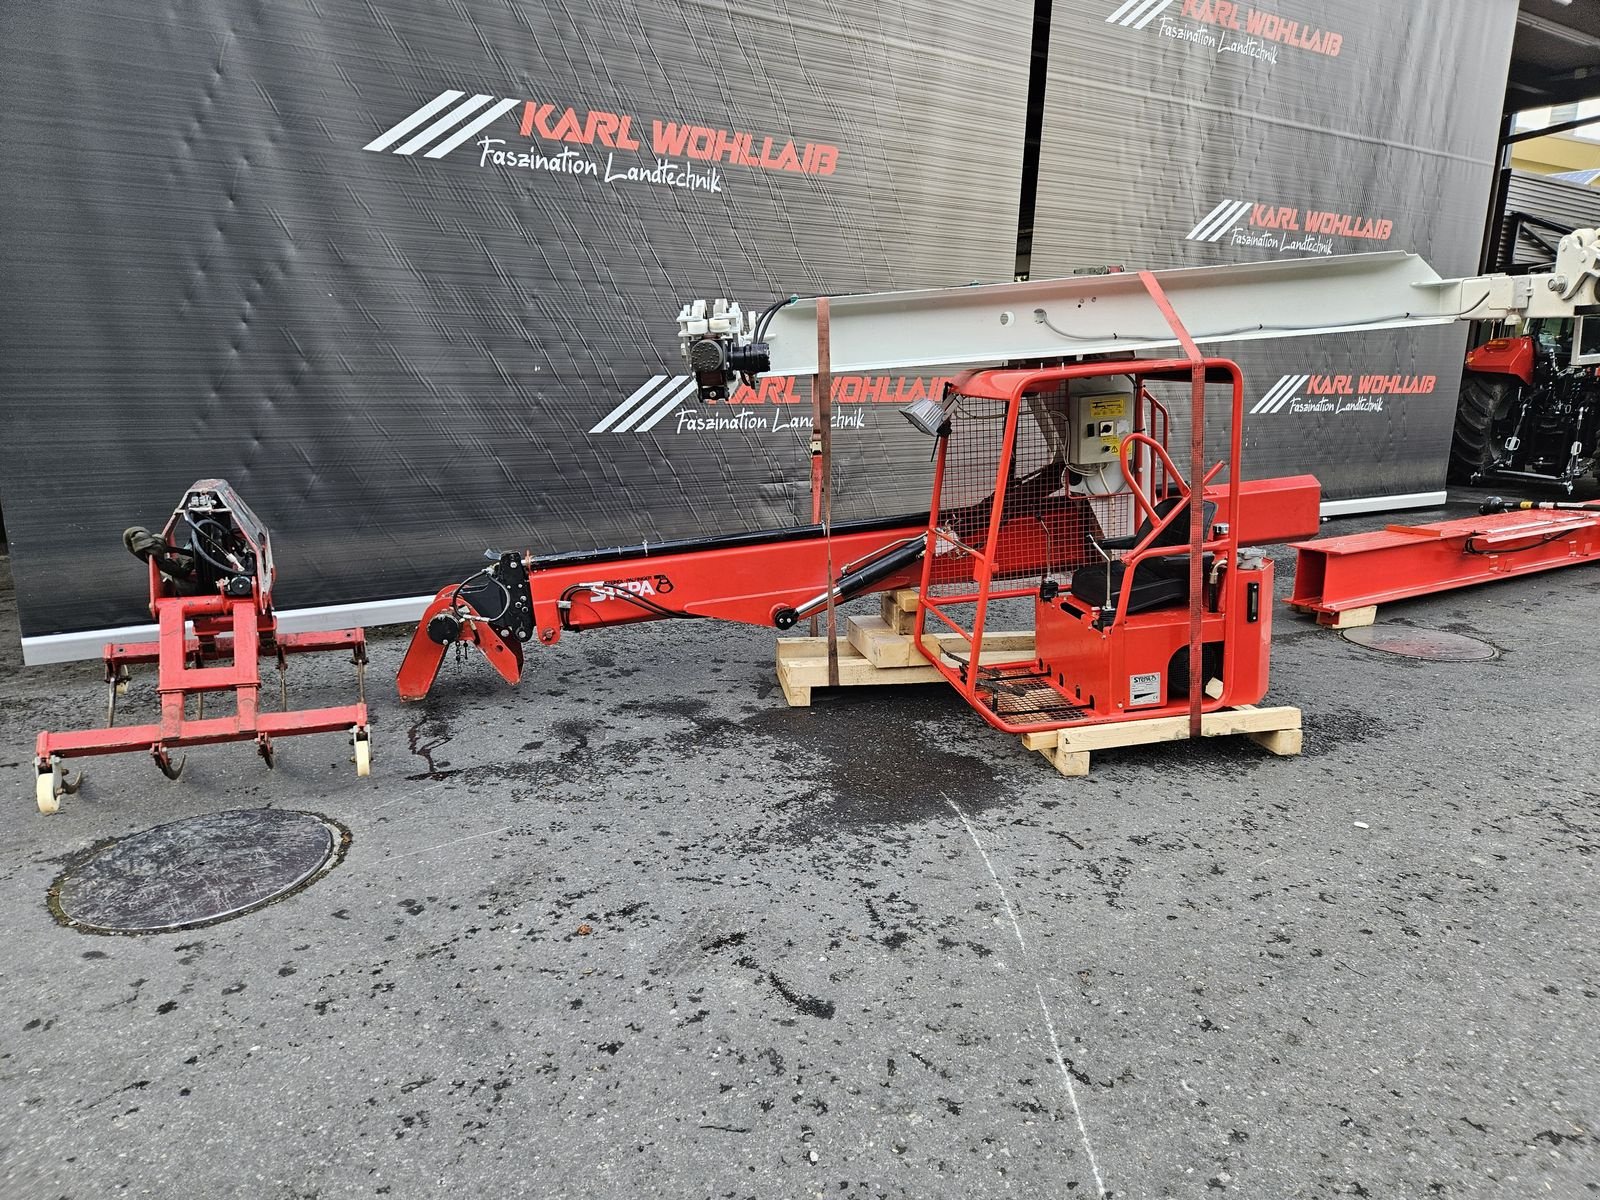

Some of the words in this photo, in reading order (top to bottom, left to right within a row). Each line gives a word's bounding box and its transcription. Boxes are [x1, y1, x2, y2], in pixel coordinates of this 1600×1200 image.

[1181, 0, 1240, 30] KARL
[1159, 15, 1216, 48] Faszination
[1217, 31, 1278, 64] Landtechnik
[520, 101, 640, 151] KARL
[477, 136, 598, 176] Faszination
[604, 152, 722, 193] Landtechnik
[1250, 203, 1299, 231] KARL
[1231, 226, 1279, 248] Faszination
[1280, 232, 1333, 255] Landtechnik
[707, 376, 801, 404] ARL
[1307, 374, 1354, 395] KARL
[1289, 396, 1335, 414] Faszination
[1335, 396, 1384, 414] Landtechnik
[675, 407, 767, 434] Faszination
